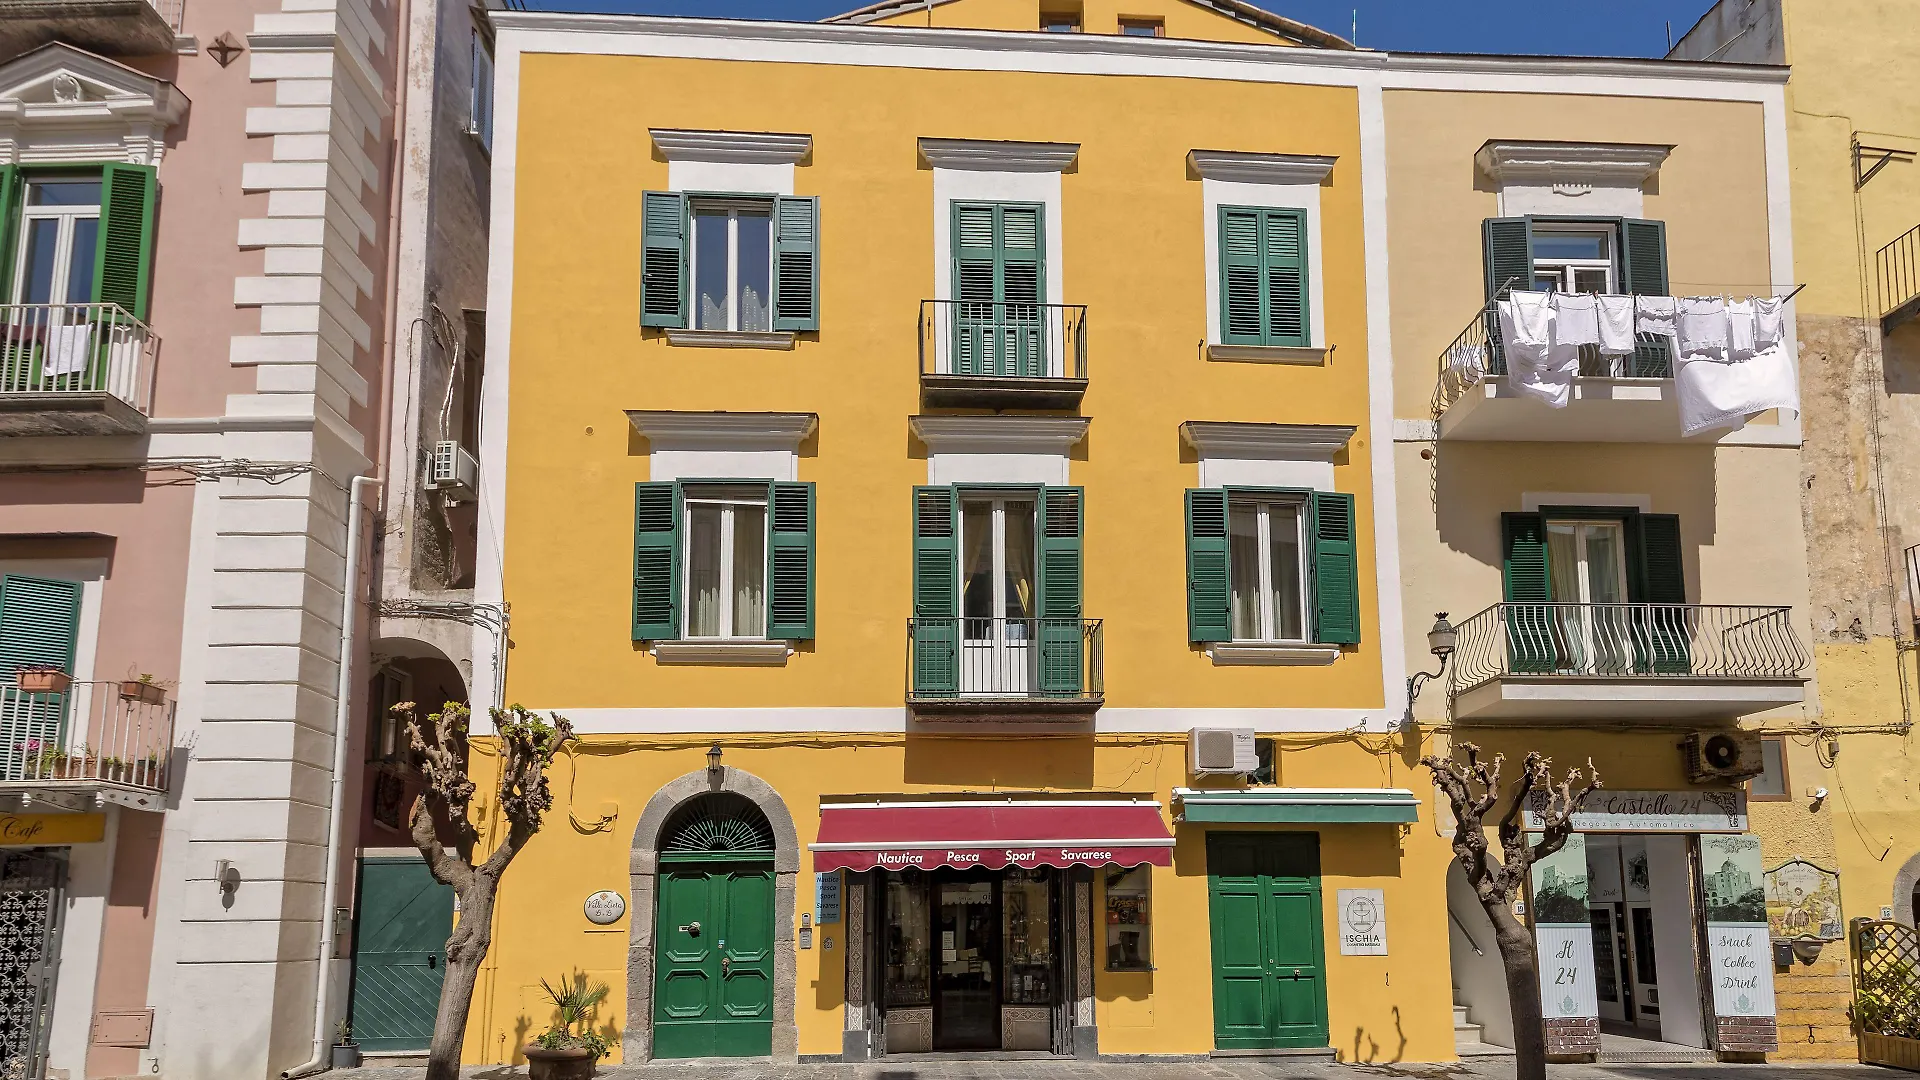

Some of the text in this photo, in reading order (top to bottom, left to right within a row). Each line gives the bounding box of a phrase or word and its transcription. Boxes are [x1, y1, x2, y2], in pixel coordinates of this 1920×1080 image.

[1604, 793, 1677, 816] Castello
[1679, 799, 1701, 815] 24
[1574, 820, 1695, 829] Negozio Automatico
[877, 849, 1112, 864] Nautica Pesca Sport Savarese
[1345, 934, 1380, 942] ISCHIA
[1718, 933, 1753, 948] Snack
[1555, 966, 1577, 985] 24
[1720, 975, 1758, 989] Drink
